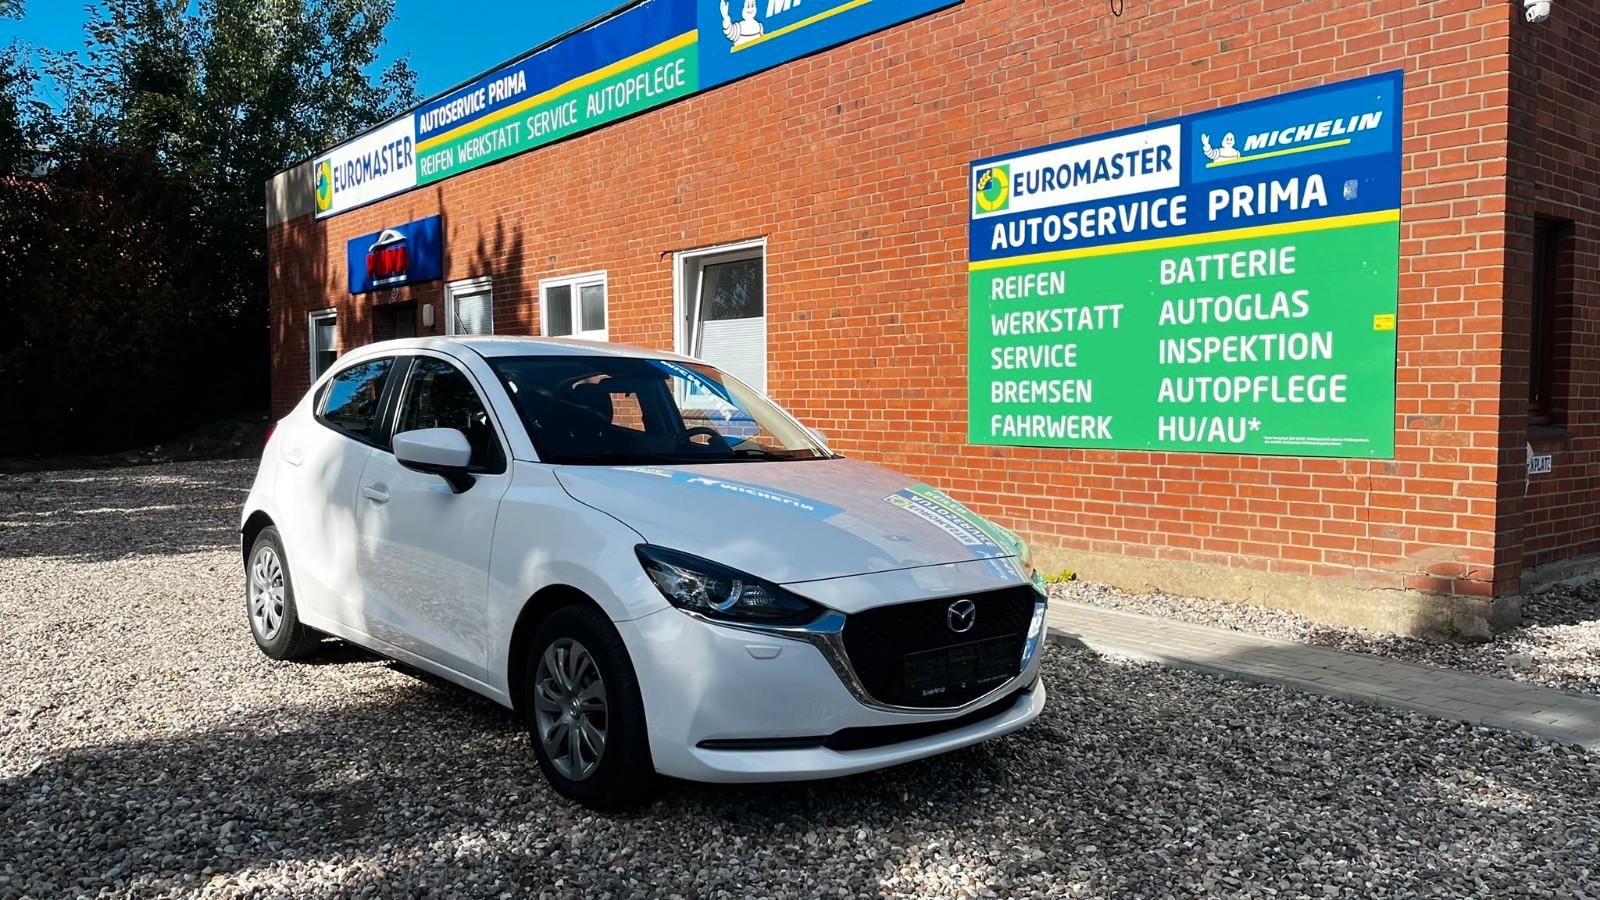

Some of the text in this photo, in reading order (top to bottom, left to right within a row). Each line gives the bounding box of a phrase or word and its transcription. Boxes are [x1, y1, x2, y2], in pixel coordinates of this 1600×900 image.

[419, 70, 527, 134] AUTOSERVICE PRIMA
[420, 58, 685, 177] REIFEN WERKSTATT SERVICE AUTOPFLEGE
[1243, 111, 1382, 152] MICHELIN
[334, 136, 413, 194] EUROMASTER
[1013, 143, 1173, 198] EUROMASTER
[991, 173, 1328, 250] AUTOSERVICE PRIMA
[1160, 246, 1296, 286] BATTERIE
[991, 271, 1066, 300] REIFEN
[991, 304, 1124, 336] WERKSTATT
[1158, 290, 1309, 326] AUTOGLAS
[991, 343, 1077, 370] SERVICE
[1159, 331, 1333, 365] INSPEKTION
[991, 379, 1092, 404] BREMSEN
[1158, 374, 1347, 403] AUTOPFLEGE
[991, 415, 1113, 440] FAHRWERK
